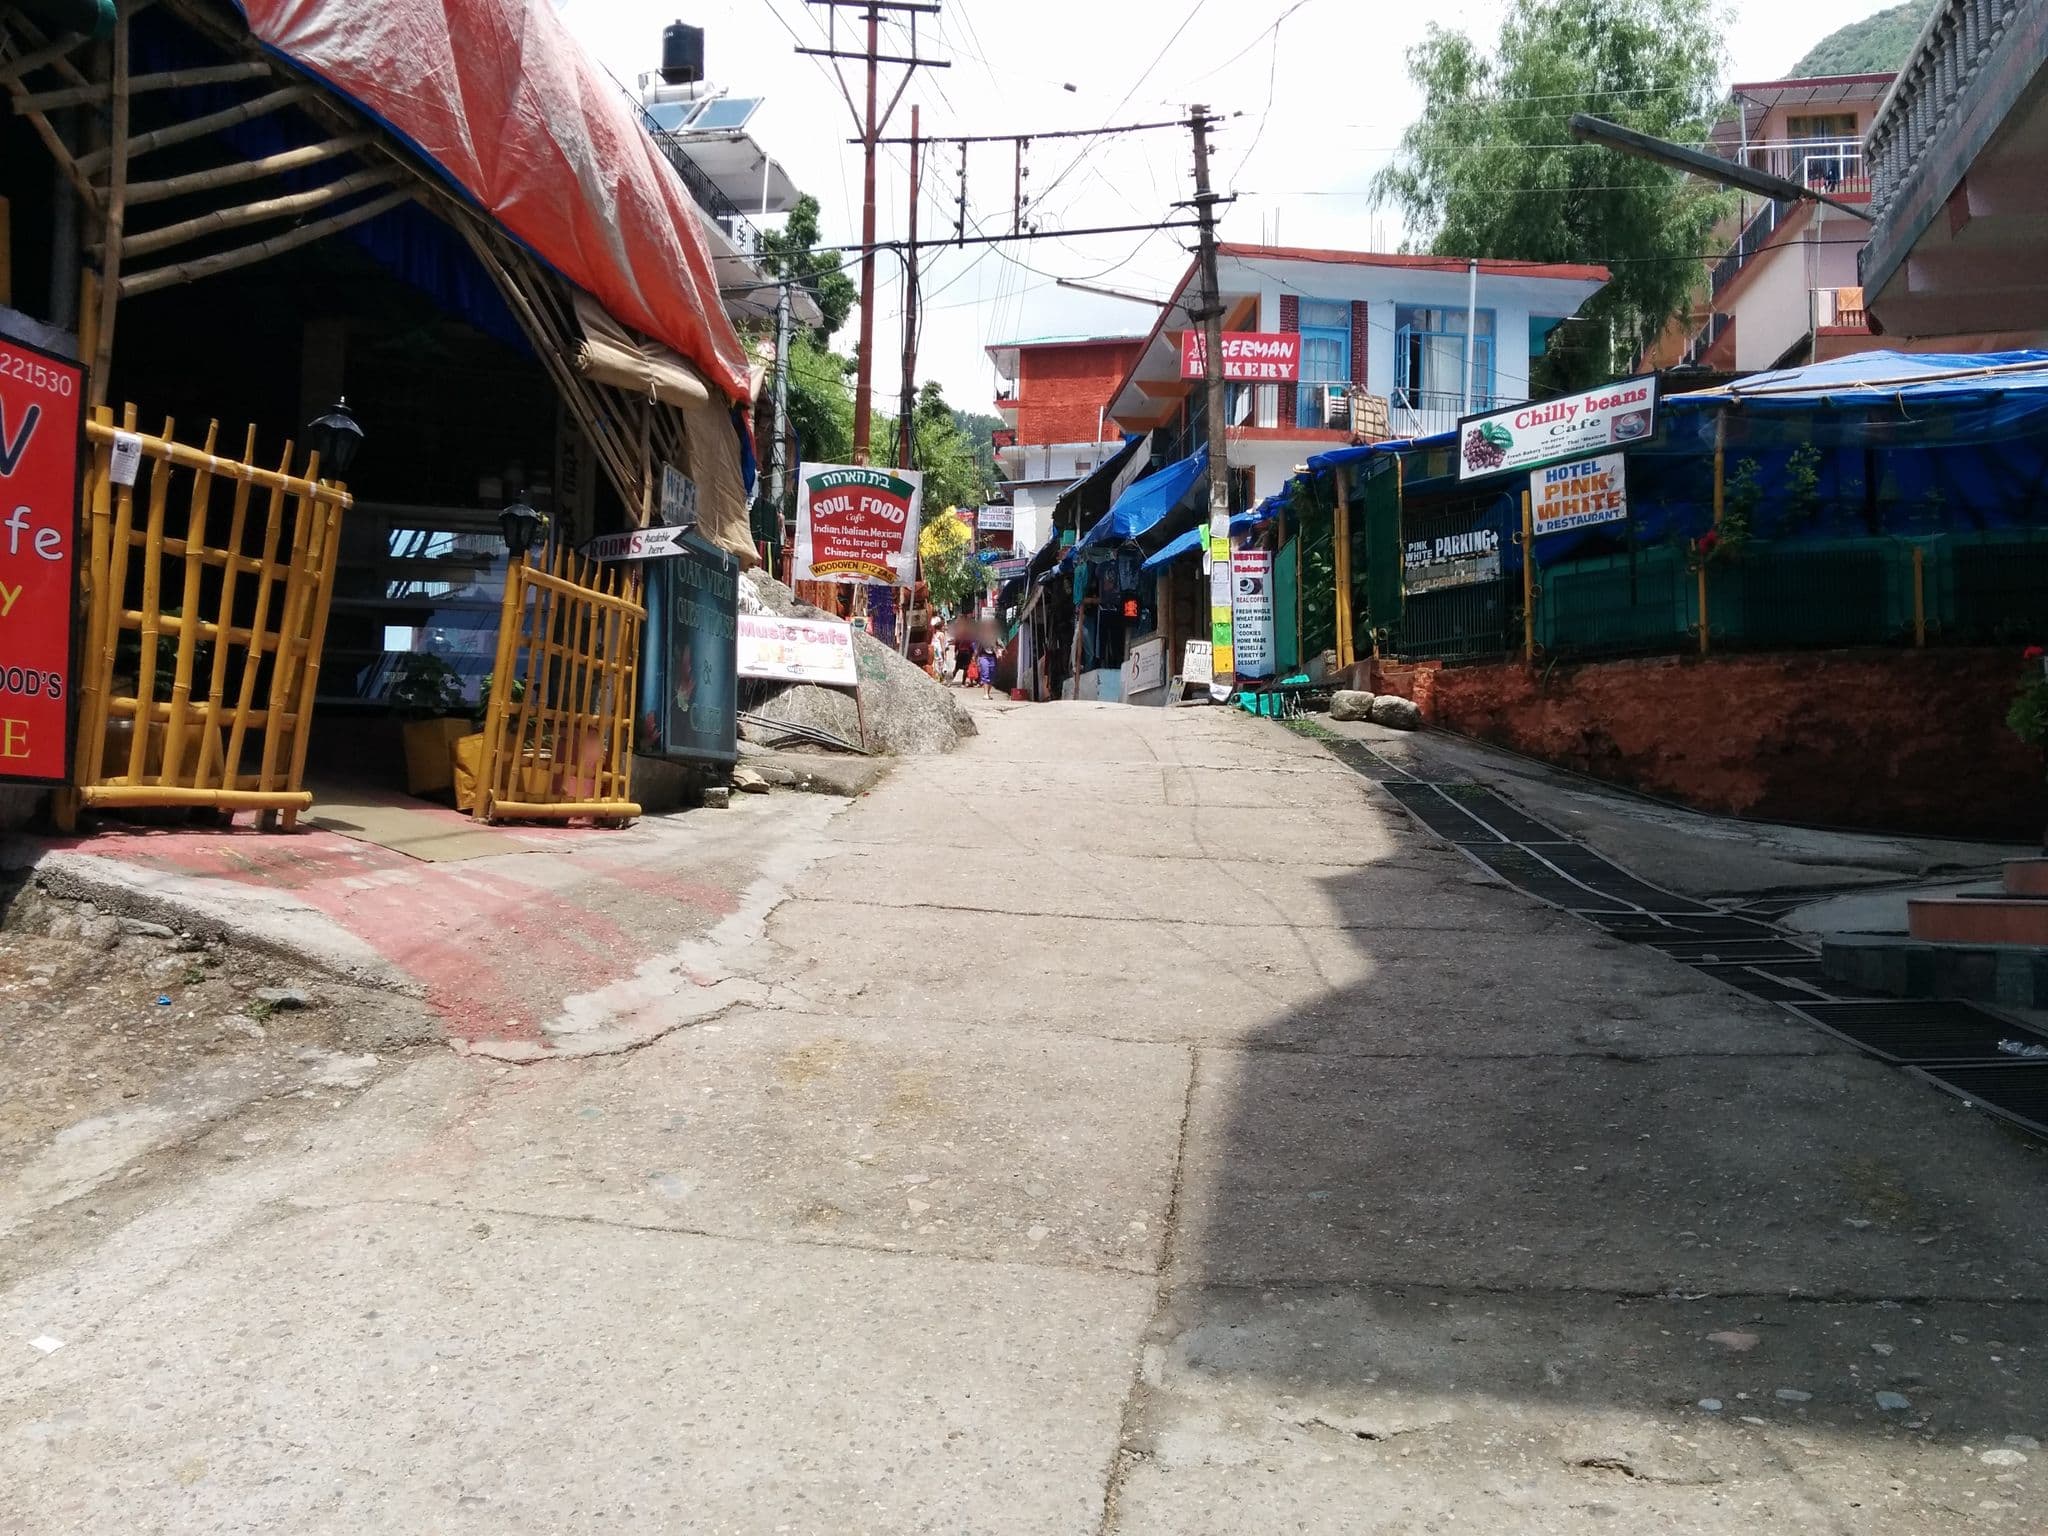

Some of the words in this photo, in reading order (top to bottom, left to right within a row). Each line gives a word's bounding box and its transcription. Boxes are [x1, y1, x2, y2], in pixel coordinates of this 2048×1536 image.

[1189, 361, 1295, 378] BKERY
[1515, 402, 1579, 430] Chilly
[1585, 387, 1647, 413] beans
[1549, 418, 1601, 436] Cafe
[1545, 461, 1601, 483] HOTEL
[813, 495, 854, 518] SOUL
[860, 496, 905, 524] FOOD
[1537, 491, 1621, 521] WHITE
[1547, 509, 1620, 530] RESTAURANT
[589, 535, 643, 557] ROOMS
[824, 546, 860, 558] Chinese
[861, 549, 883, 560] Food
[1408, 540, 1428, 552] PINK
[1435, 529, 1491, 558] PARKING
[1405, 549, 1433, 562] WHITE
[812, 561, 859, 574] WOODOVEN
[1234, 565, 1270, 574] Bakery
[739, 621, 798, 641] Music
[802, 627, 848, 645] Cafe
